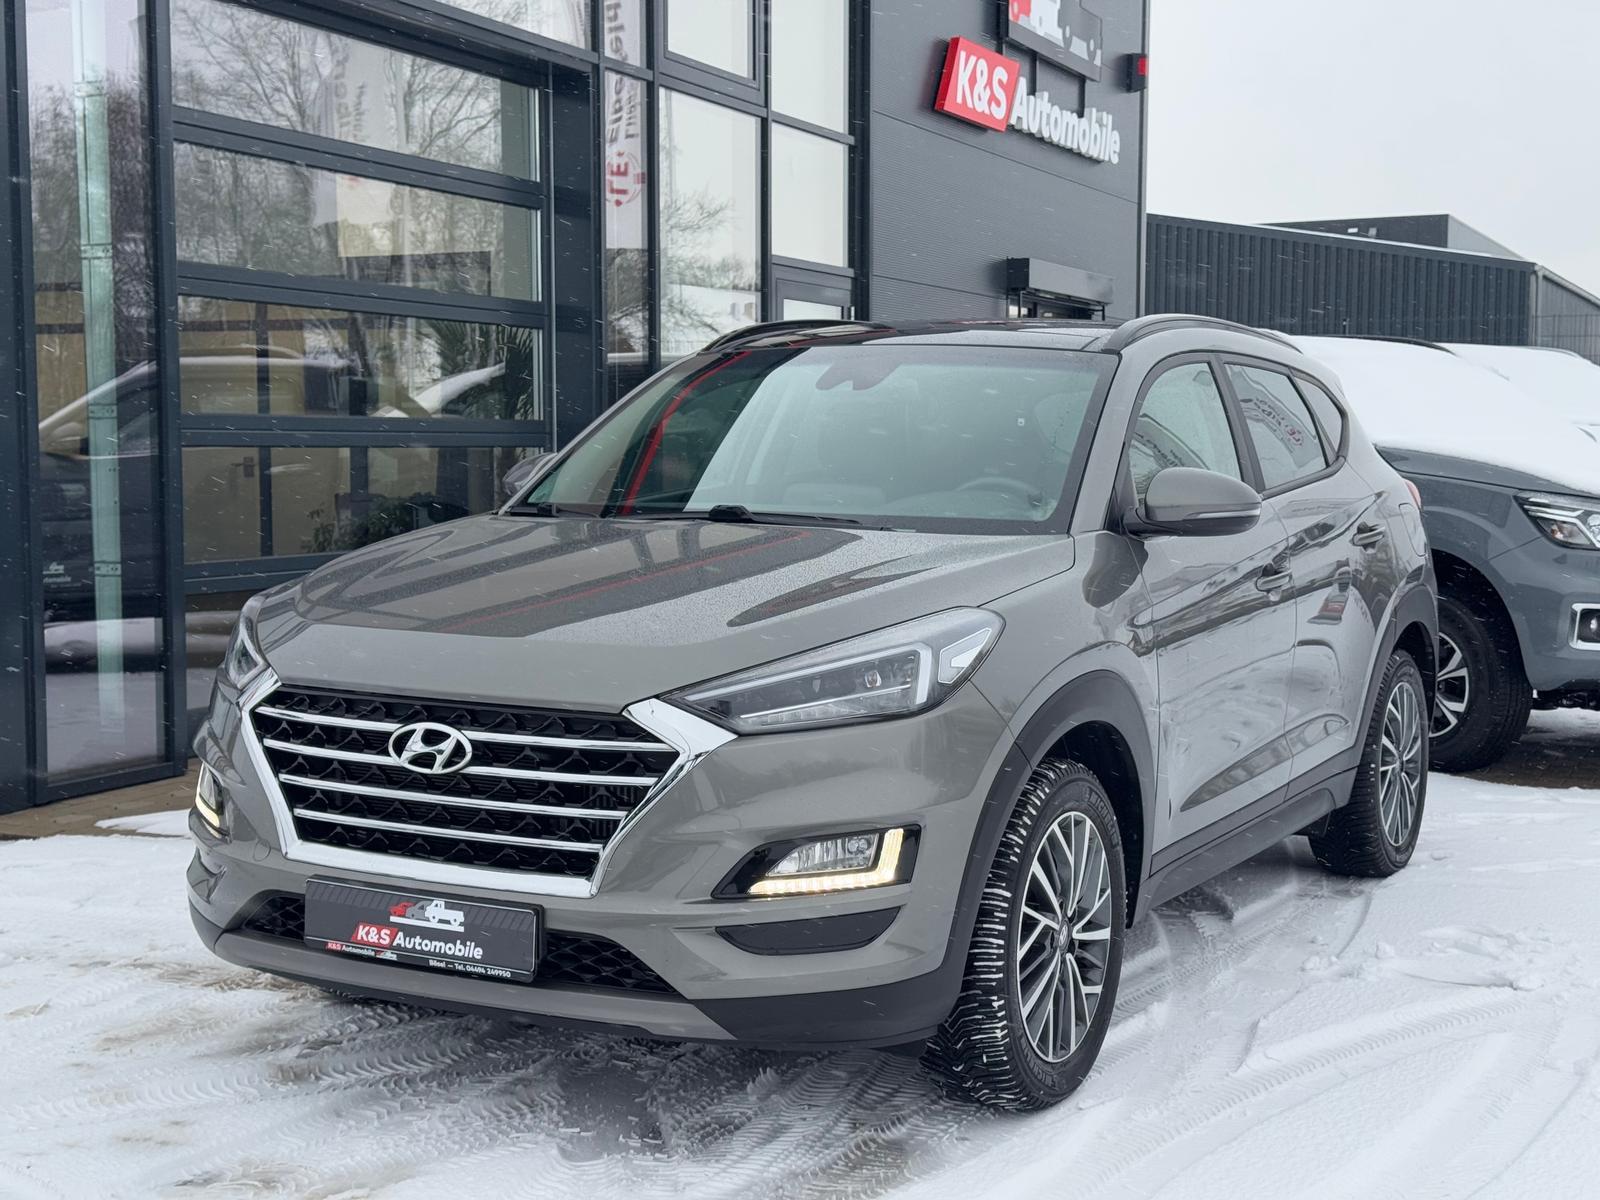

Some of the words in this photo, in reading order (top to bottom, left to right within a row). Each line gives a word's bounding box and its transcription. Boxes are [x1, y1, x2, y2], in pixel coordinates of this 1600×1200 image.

[956, 50, 1008, 120] K&S
[1010, 76, 1121, 165] Automobile
[327, 942, 342, 951] K&S
[341, 945, 376, 957] Automobile
[357, 924, 391, 945] K&S
[393, 931, 483, 959] Automobile
[455, 963, 465, 971] Tel.
